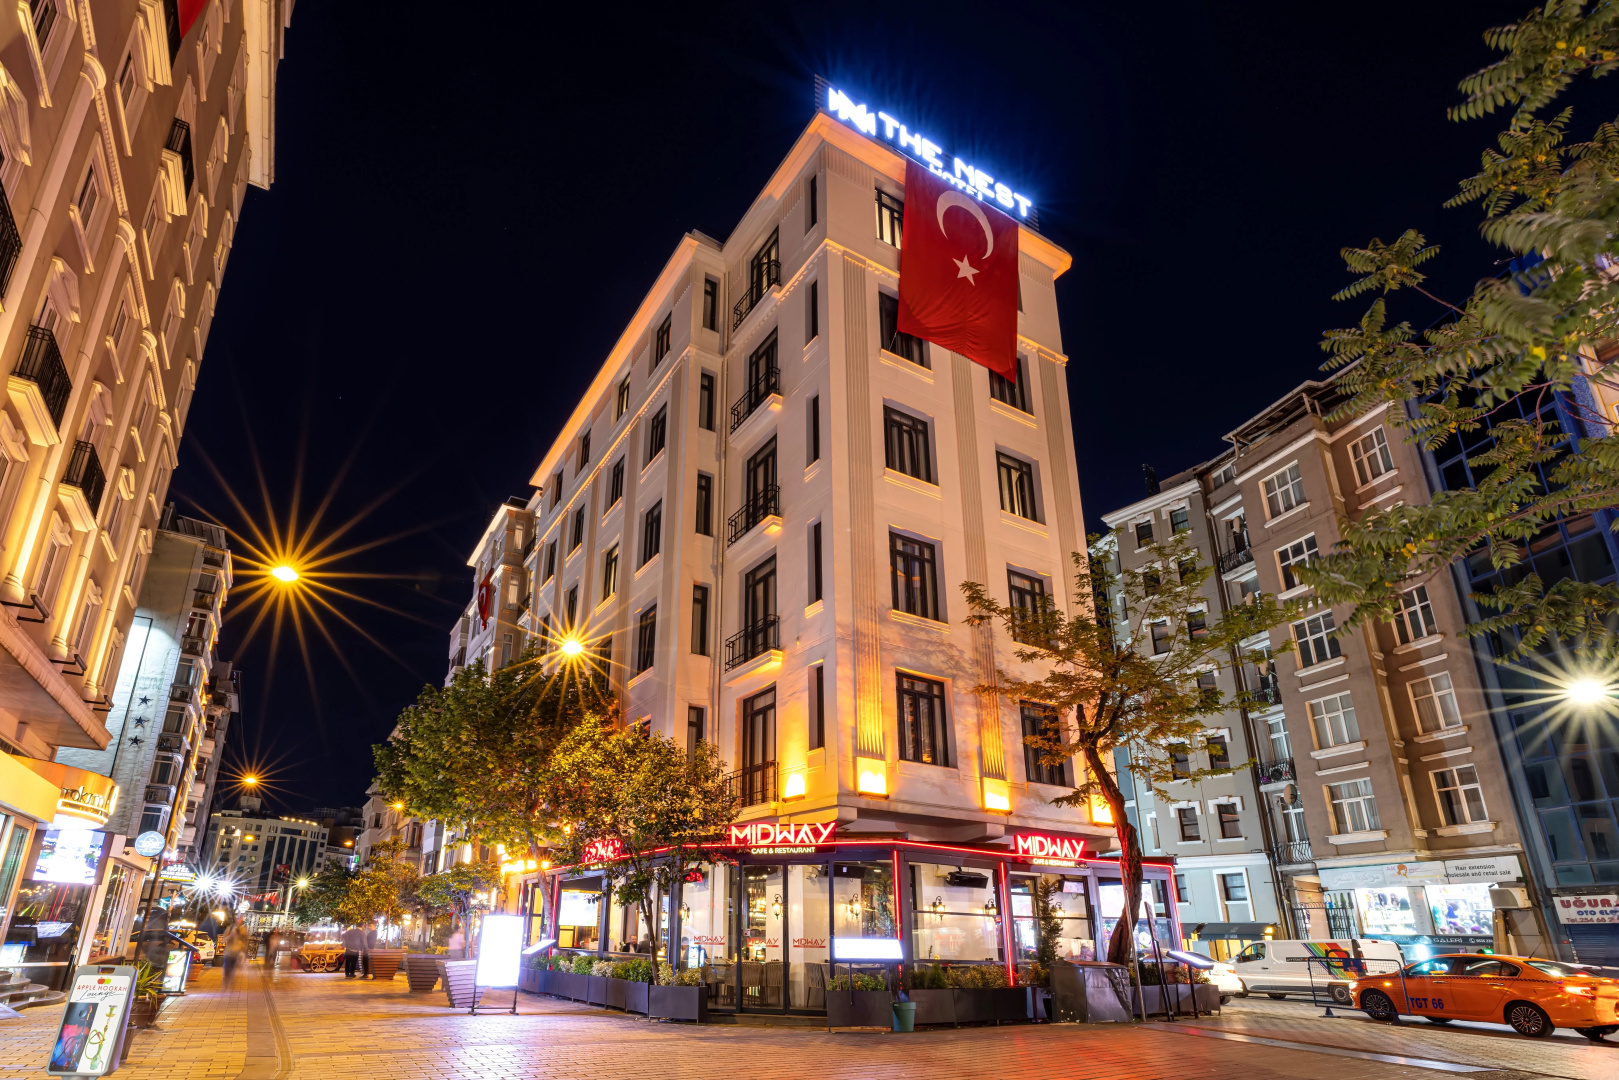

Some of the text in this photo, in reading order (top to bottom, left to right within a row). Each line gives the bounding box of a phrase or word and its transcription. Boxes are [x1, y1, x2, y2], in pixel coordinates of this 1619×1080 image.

[878, 111, 1032, 218] THE NEST
[731, 822, 836, 845] MIDWAY
[751, 847, 768, 855] CAFE
[774, 846, 816, 854] RESTAURANT
[1016, 834, 1085, 859] MIDWAY
[1033, 857, 1045, 865] CAFE
[1560, 896, 1613, 908] UĞUR
[694, 935, 725, 943] MIDWAY
[746, 936, 779, 945] MIDWAY
[793, 938, 826, 946] MIDWAY
[1409, 997, 1445, 1010] TGT 66
